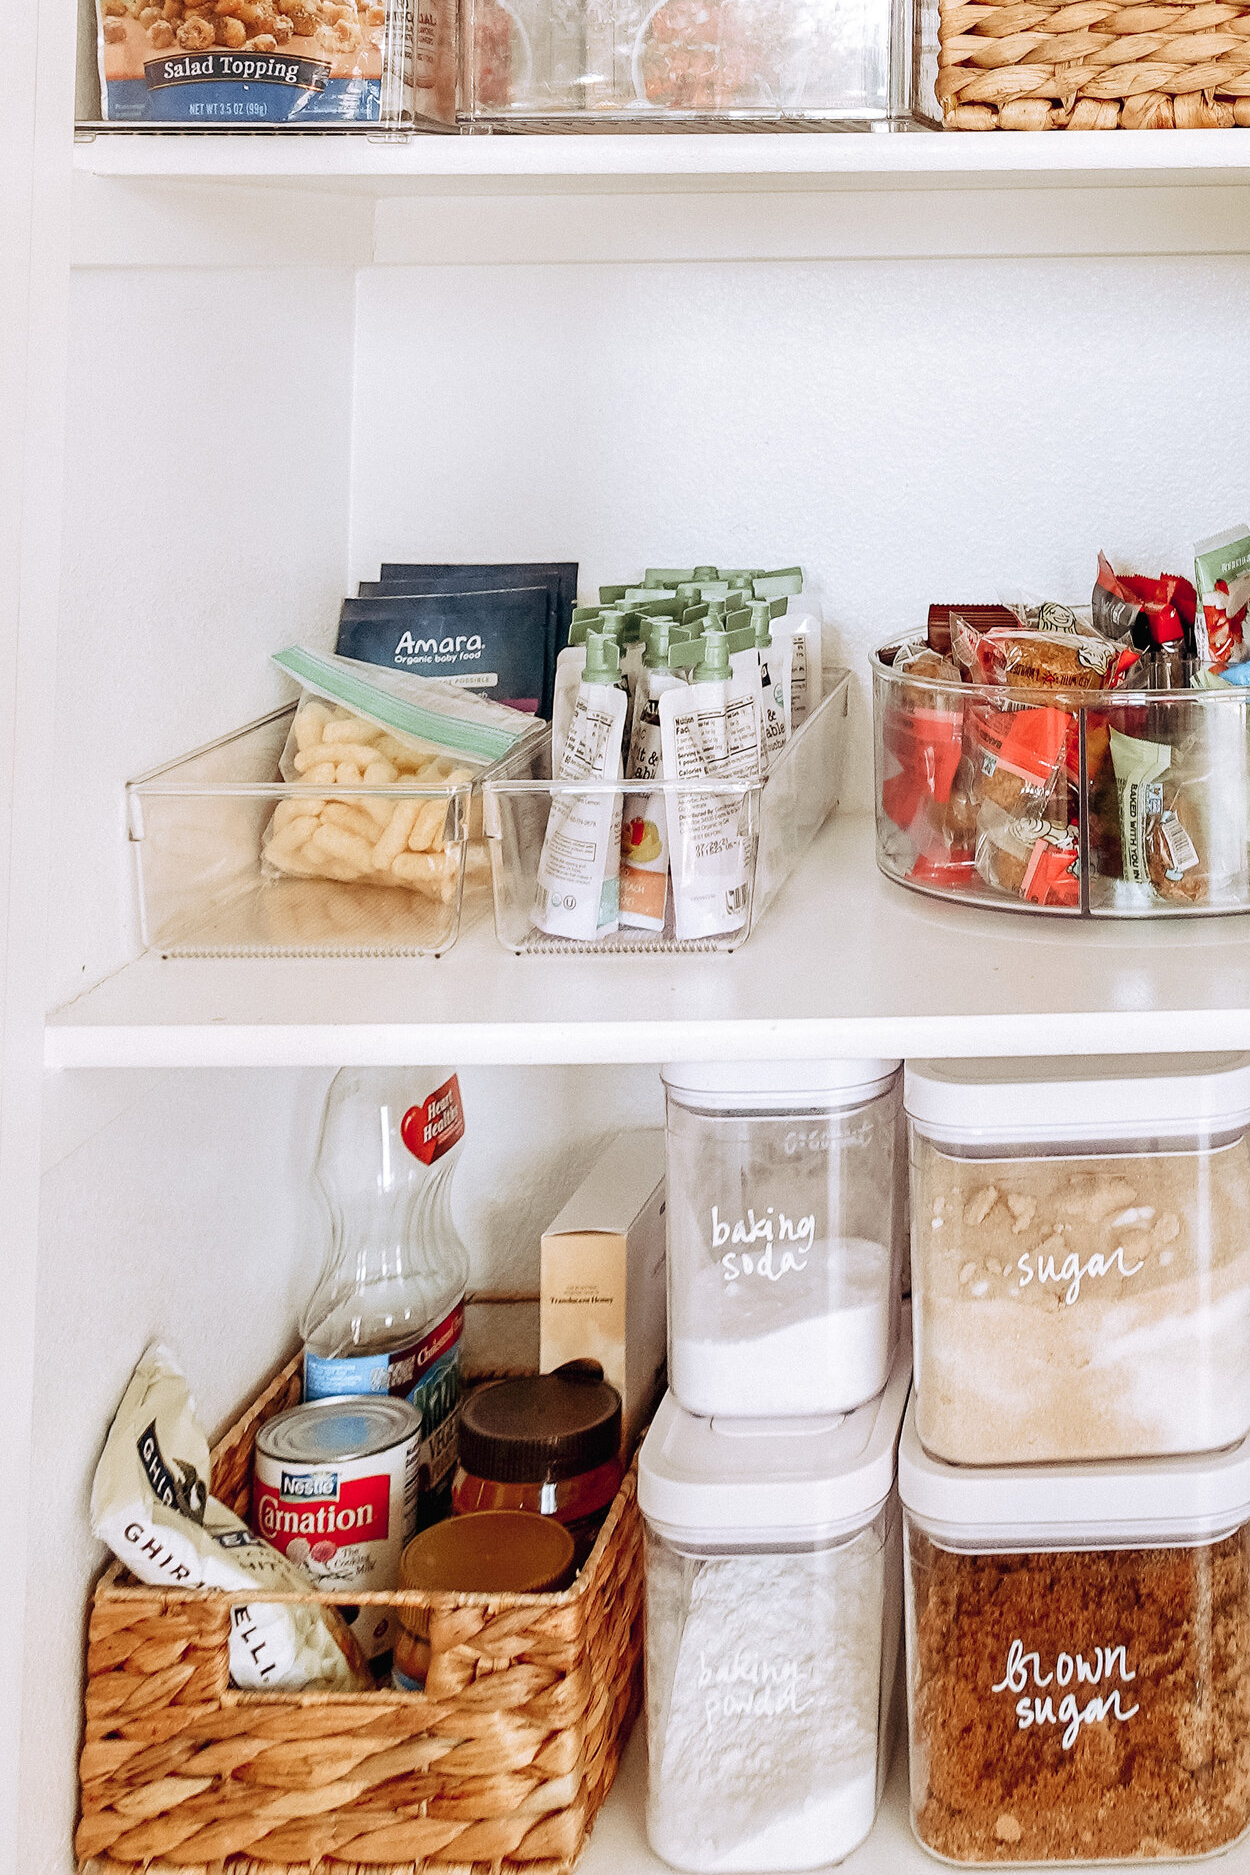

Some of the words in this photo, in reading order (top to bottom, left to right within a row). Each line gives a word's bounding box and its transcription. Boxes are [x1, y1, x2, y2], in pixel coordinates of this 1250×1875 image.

[163, 56, 215, 80] Salad
[219, 56, 300, 83] Topping
[394, 654, 433, 665] Organic
[434, 653, 458, 664] baby
[459, 650, 482, 661] food
[711, 1205, 816, 1254] baking
[722, 1242, 808, 1282] soda
[1017, 1244, 1146, 1308] sugar
[259, 1494, 374, 1539] Carnation
[992, 1637, 1137, 1694] brown
[1017, 1684, 1140, 1750] sugar
